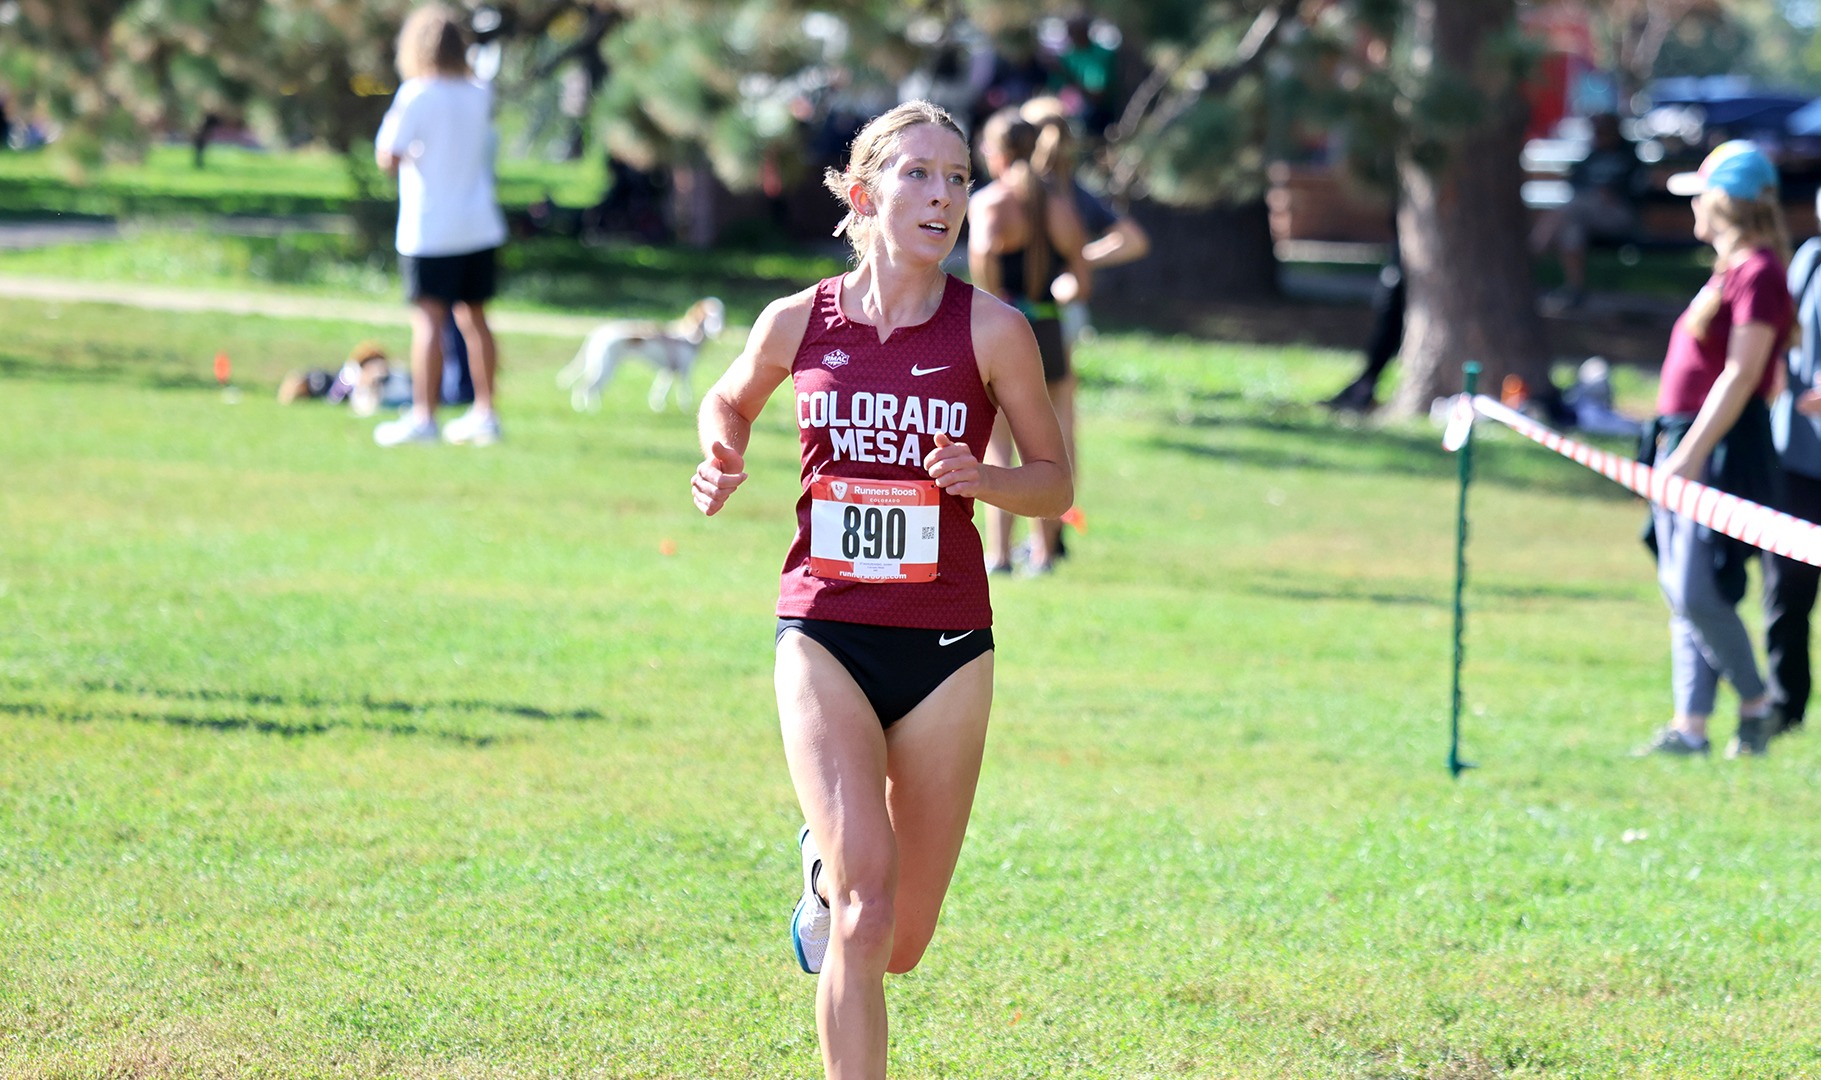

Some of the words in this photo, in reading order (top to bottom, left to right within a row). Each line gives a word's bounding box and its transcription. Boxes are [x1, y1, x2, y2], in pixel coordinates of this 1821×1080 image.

[797, 391, 967, 438] COLORADO
[829, 428, 921, 467] MESA
[854, 485, 890, 496] Runners
[891, 487, 917, 496] Roost
[842, 505, 906, 560] 890
